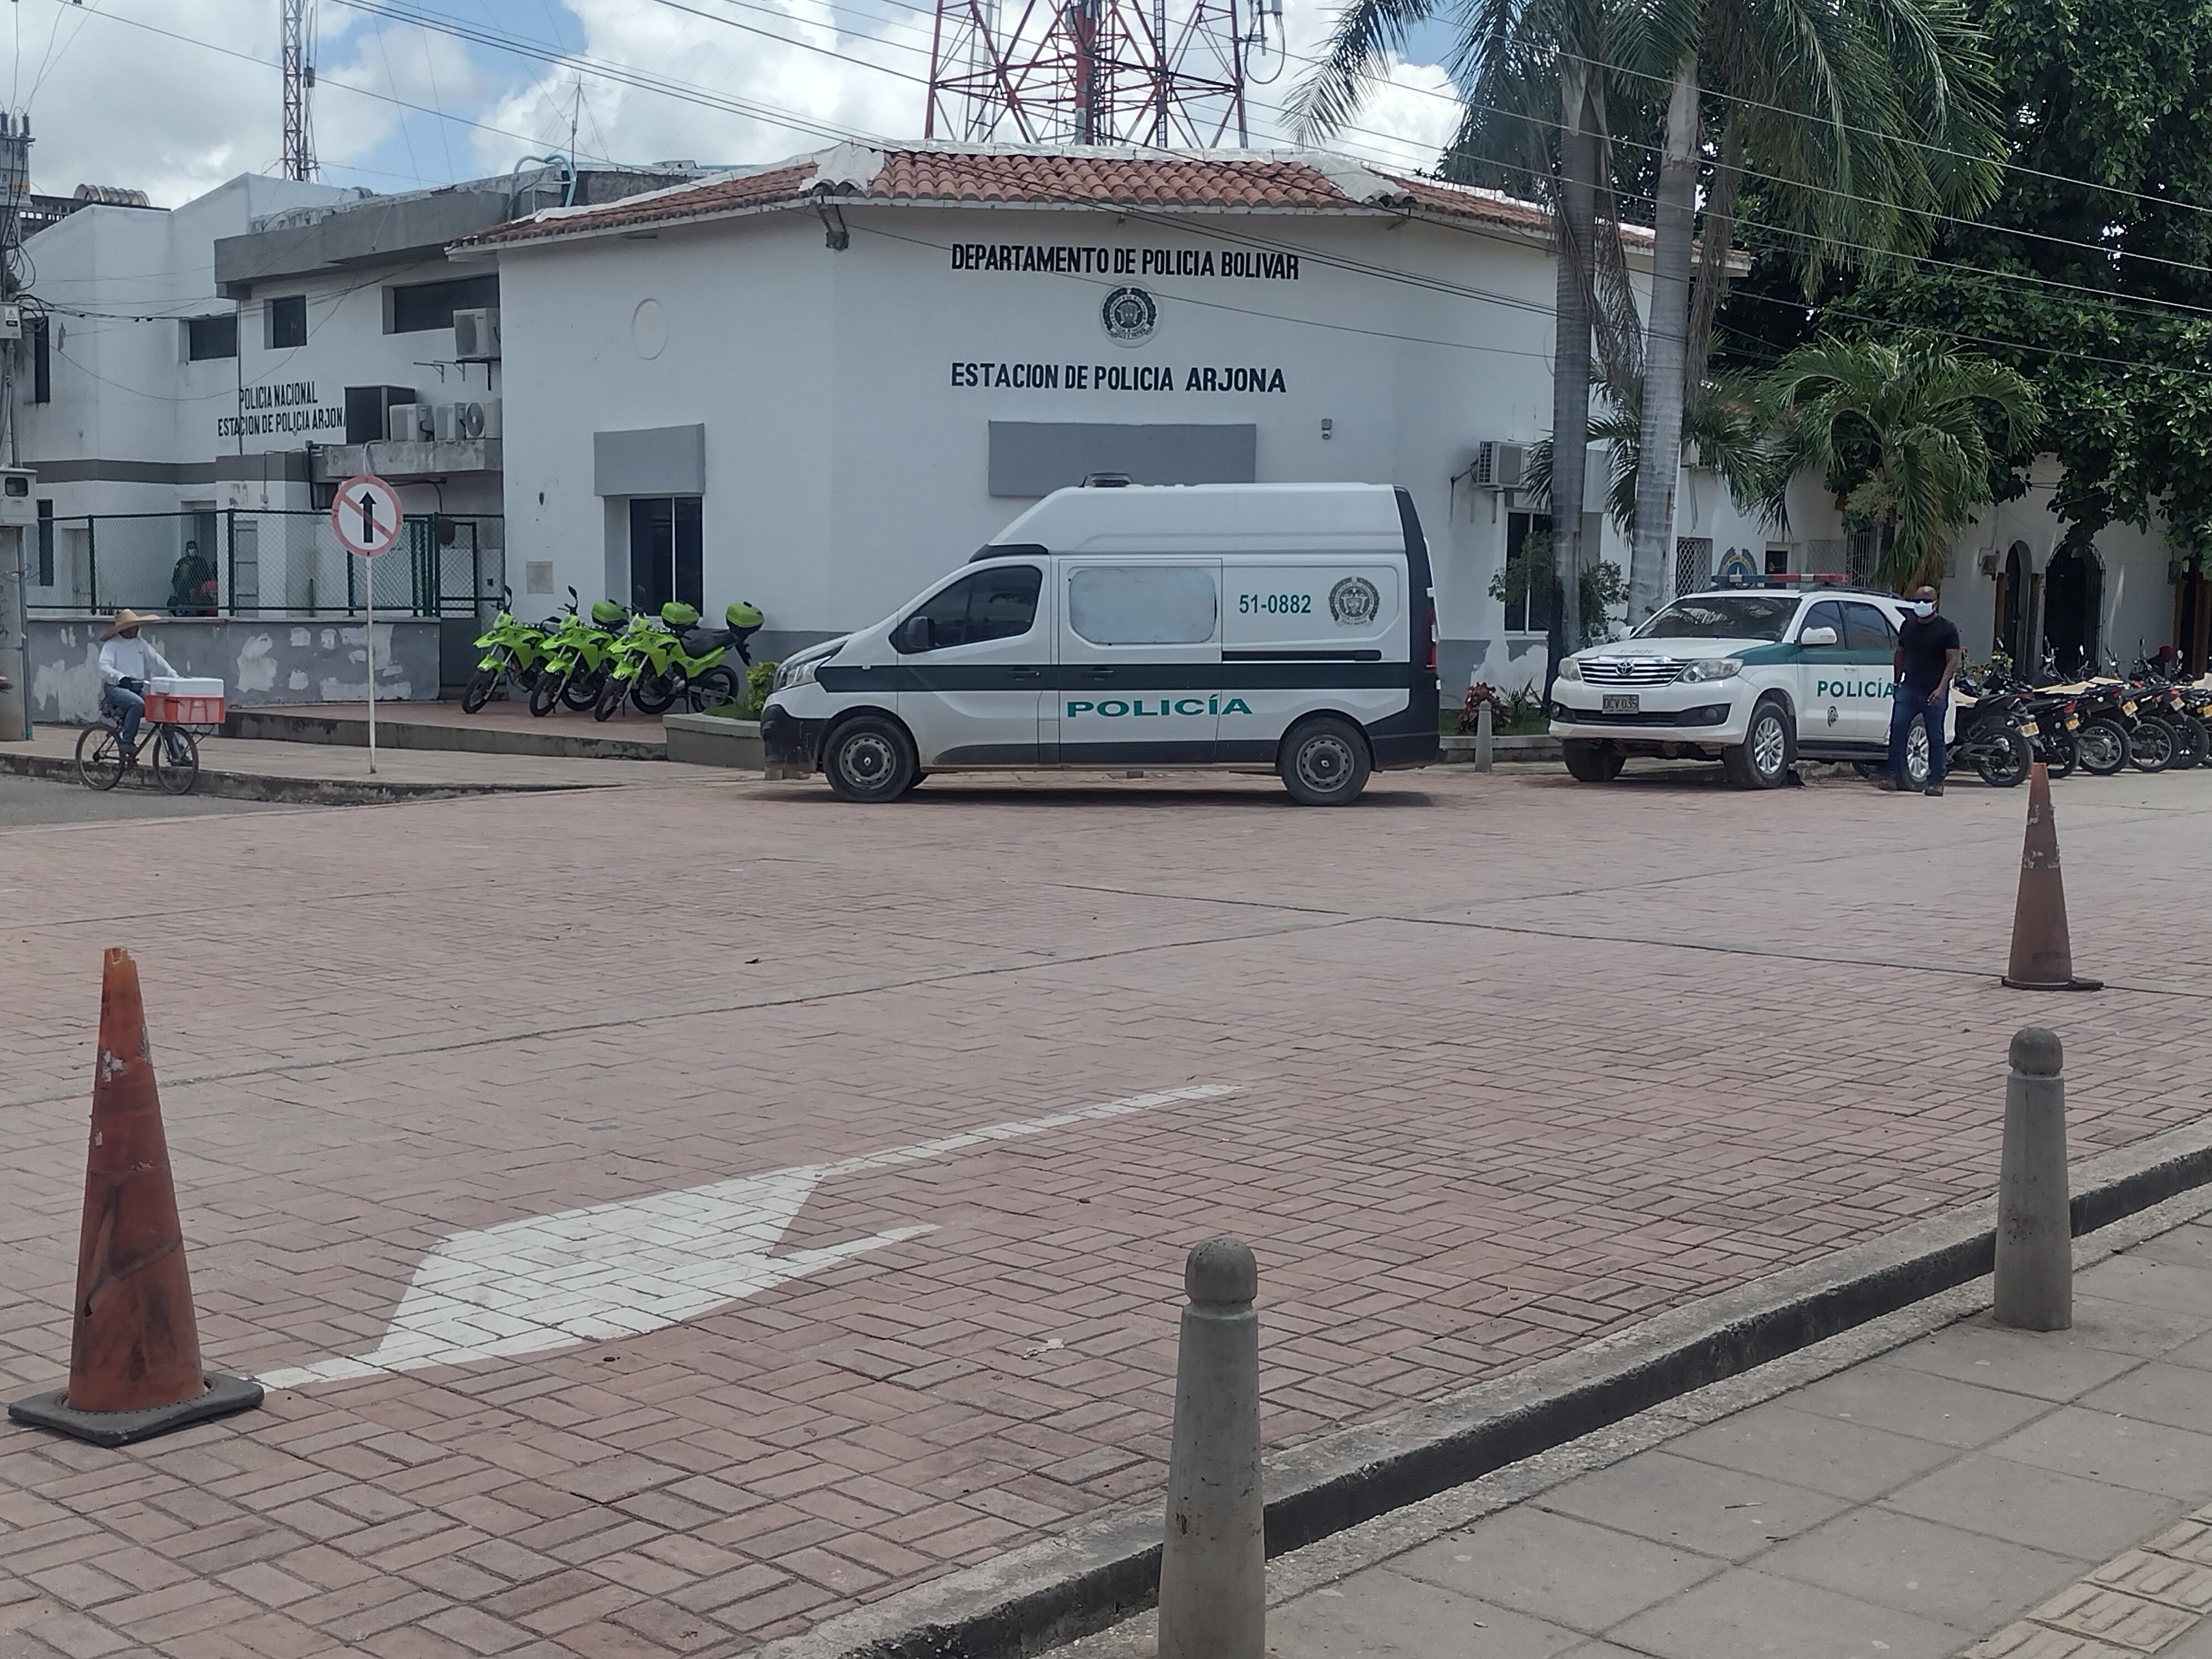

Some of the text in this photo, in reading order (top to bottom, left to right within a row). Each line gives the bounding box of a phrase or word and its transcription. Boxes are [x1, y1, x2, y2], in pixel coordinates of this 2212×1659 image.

[951, 243, 1298, 280] DEPARTAMENTO DE POLICIA BOLIVAR
[952, 362, 1286, 393] ESTACION DE POLICIA ARJONA
[239, 380, 318, 410] POLICIA NACIONAL
[218, 415, 260, 437] ESTACION
[262, 414, 274, 434] DE
[276, 410, 310, 432] POLICIA
[1239, 594, 1311, 614] 51-0882
[1817, 677, 1893, 698] POLICÍA
[1067, 694, 1253, 717] POLICÍA
